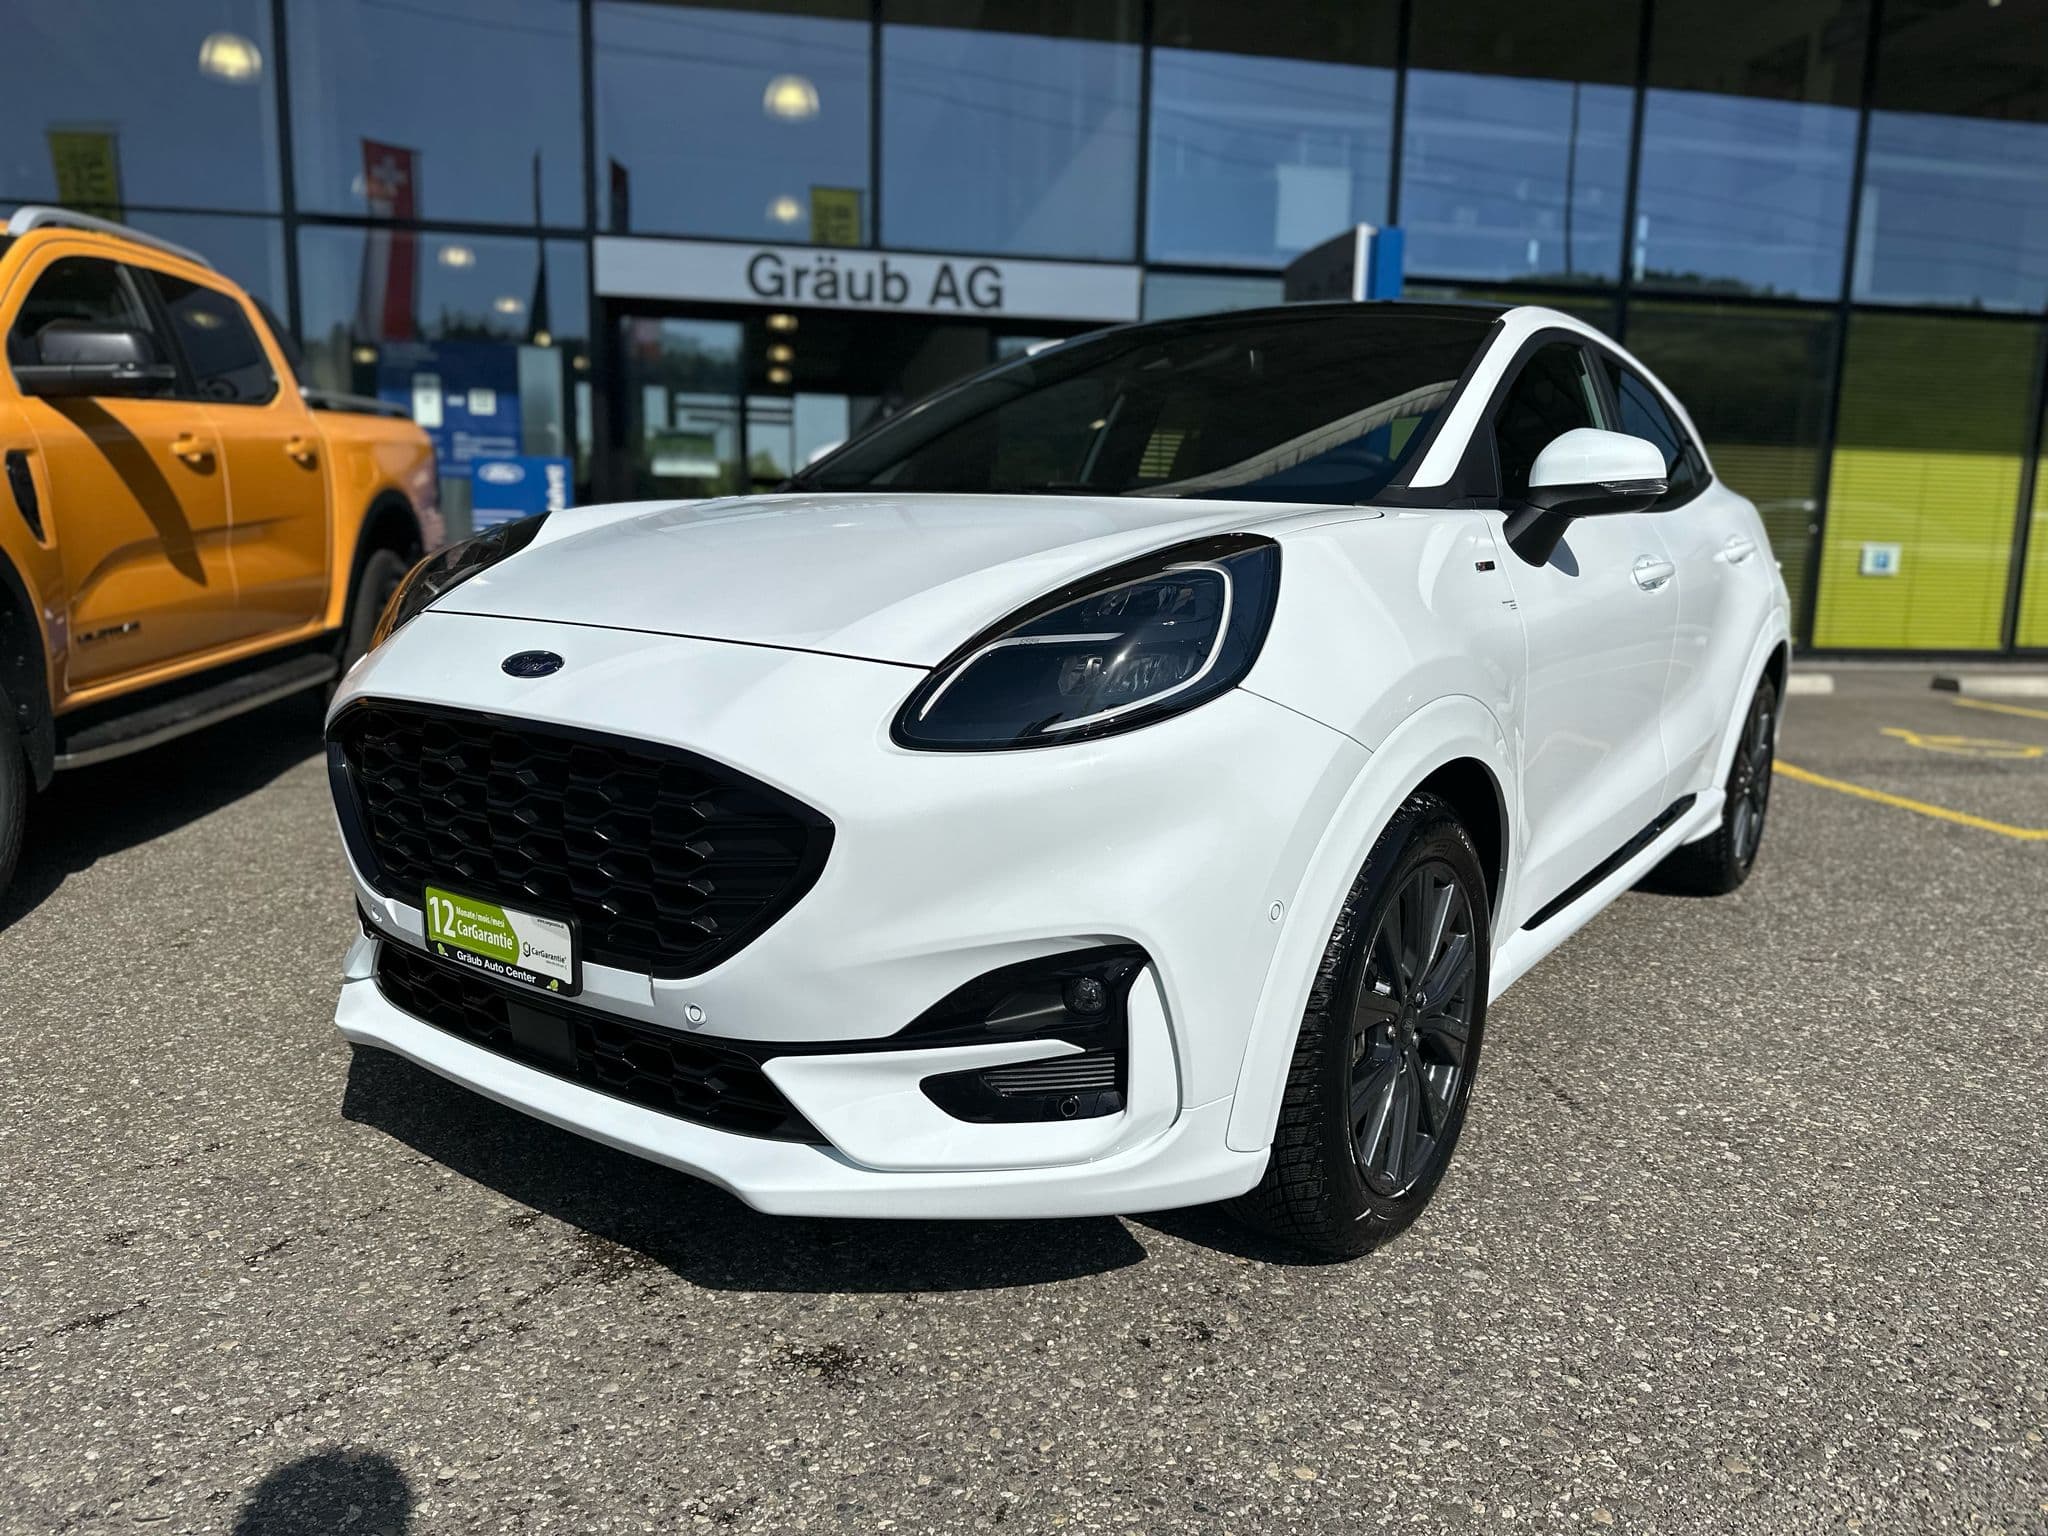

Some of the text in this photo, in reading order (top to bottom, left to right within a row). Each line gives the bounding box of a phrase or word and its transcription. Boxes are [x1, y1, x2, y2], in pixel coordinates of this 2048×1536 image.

[747, 252, 1004, 309] Gräub AG
[429, 896, 456, 938] 12
[457, 950, 536, 984] Gräub Auto Center
